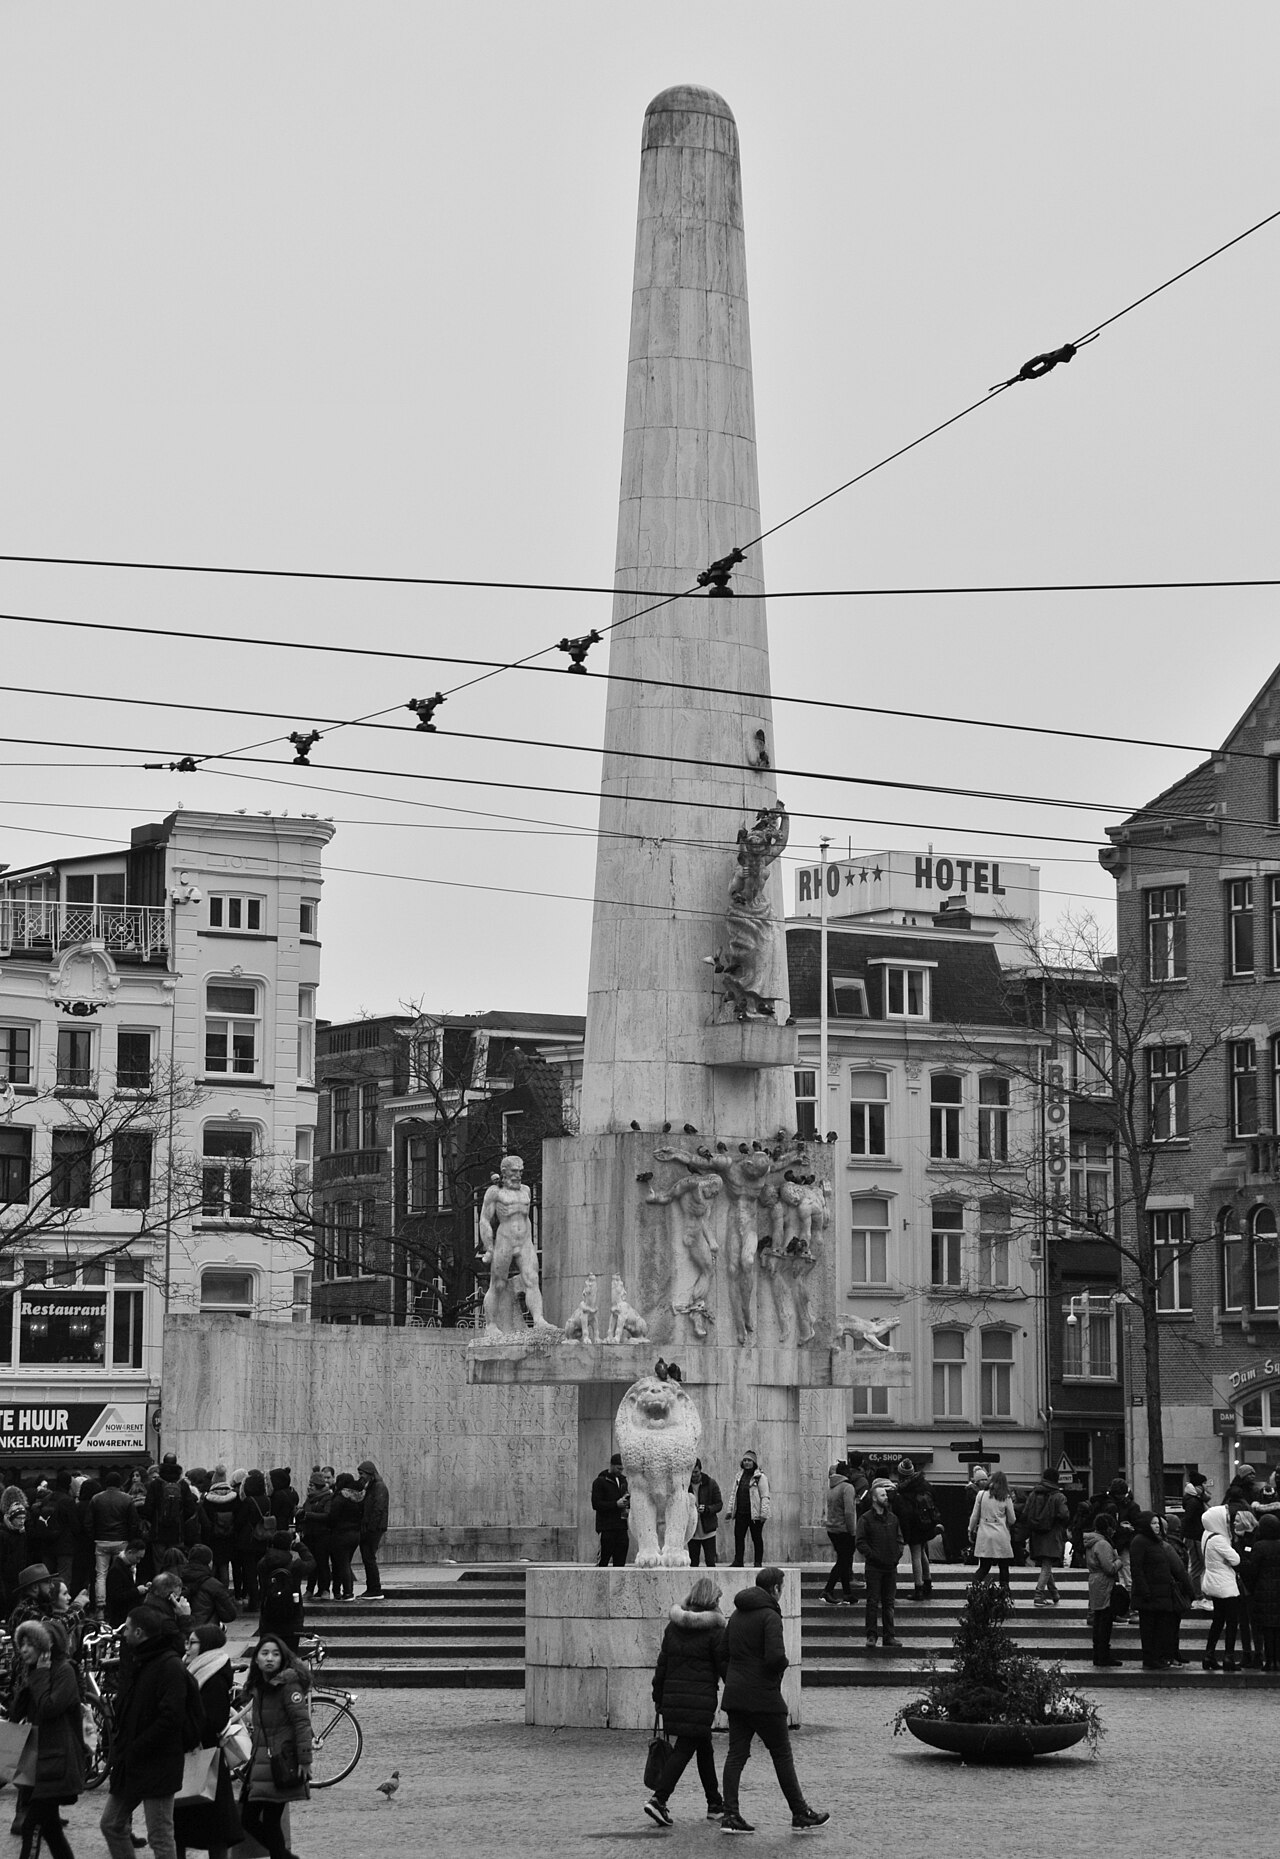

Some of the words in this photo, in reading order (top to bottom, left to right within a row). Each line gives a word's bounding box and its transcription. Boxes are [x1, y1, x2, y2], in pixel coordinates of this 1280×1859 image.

[799, 864, 840, 902] RHO
[914, 856, 1006, 896] HOTEL
[1047, 1064, 1066, 1124] RHO
[21, 1302, 106, 1316] Restaurant
[1229, 1370, 1256, 1388] Dam
[0, 1410, 14, 1431] E
[19, 1410, 69, 1431] HUUR
[0, 1435, 82, 1448] NKELRUIMTE
[87, 1439, 144, 1447] NOW4RENT.NL
[883, 1453, 903, 1461] SHOP
